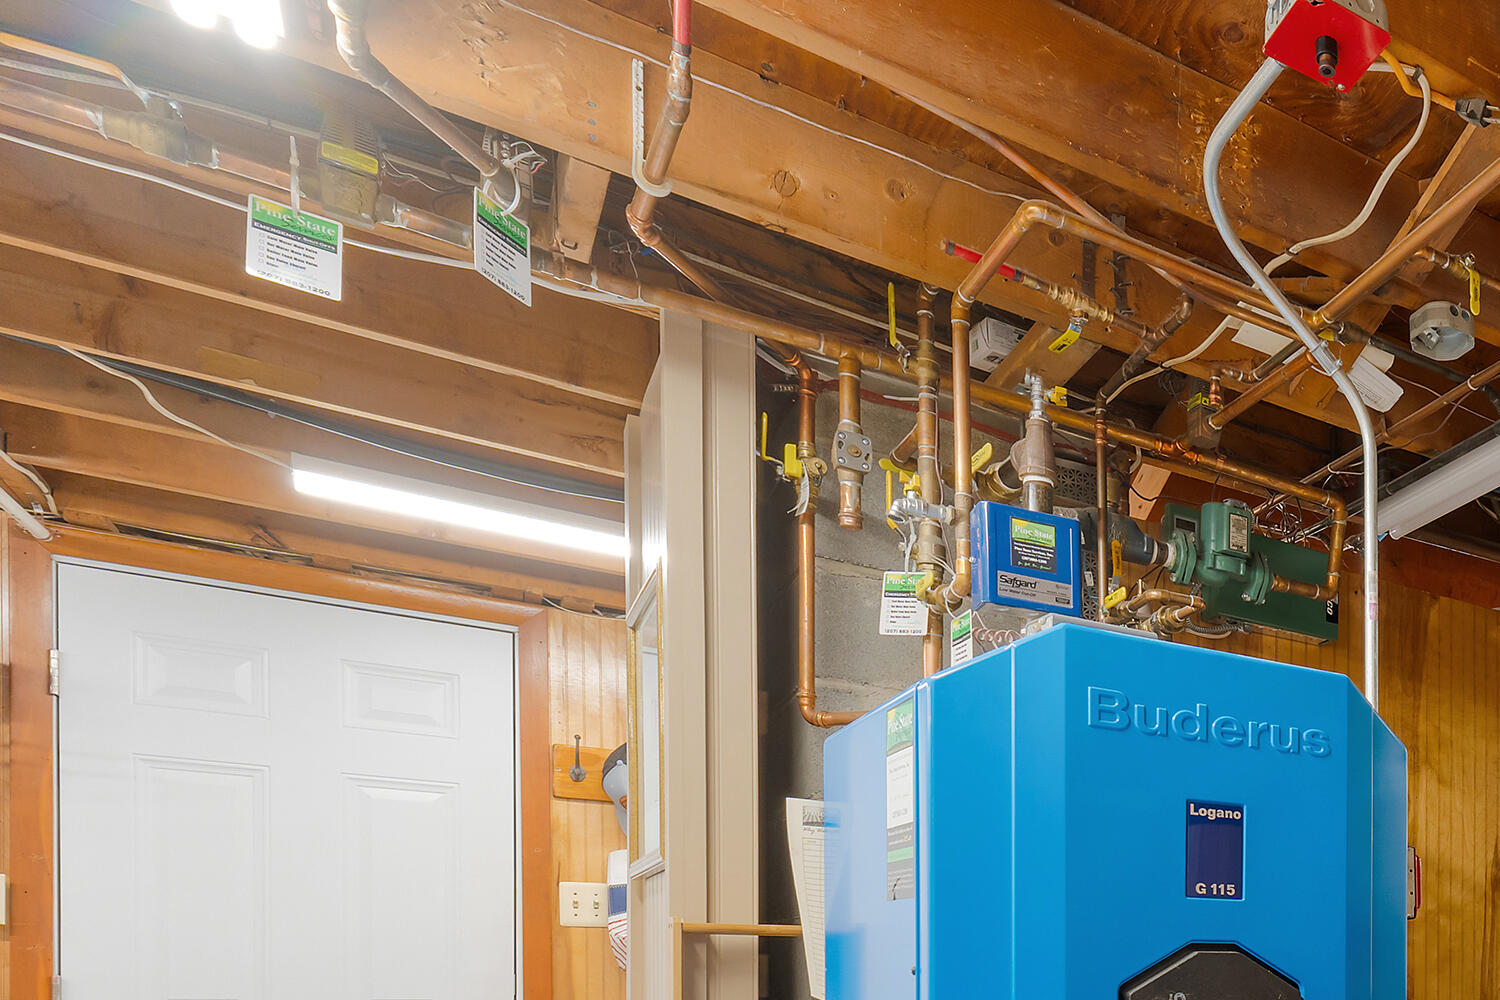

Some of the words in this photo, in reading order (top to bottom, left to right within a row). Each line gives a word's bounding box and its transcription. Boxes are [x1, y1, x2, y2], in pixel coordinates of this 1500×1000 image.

[255, 200, 293, 223] Pine
[297, 216, 335, 236] State
[501, 213, 526, 239] State
[886, 575, 905, 585] Pine
[999, 574, 1037, 589] Safgard
[1088, 686, 1331, 757] Buderus
[1189, 803, 1242, 820] Logano
[1195, 883, 1207, 895] G
[1210, 883, 1236, 896] 115
